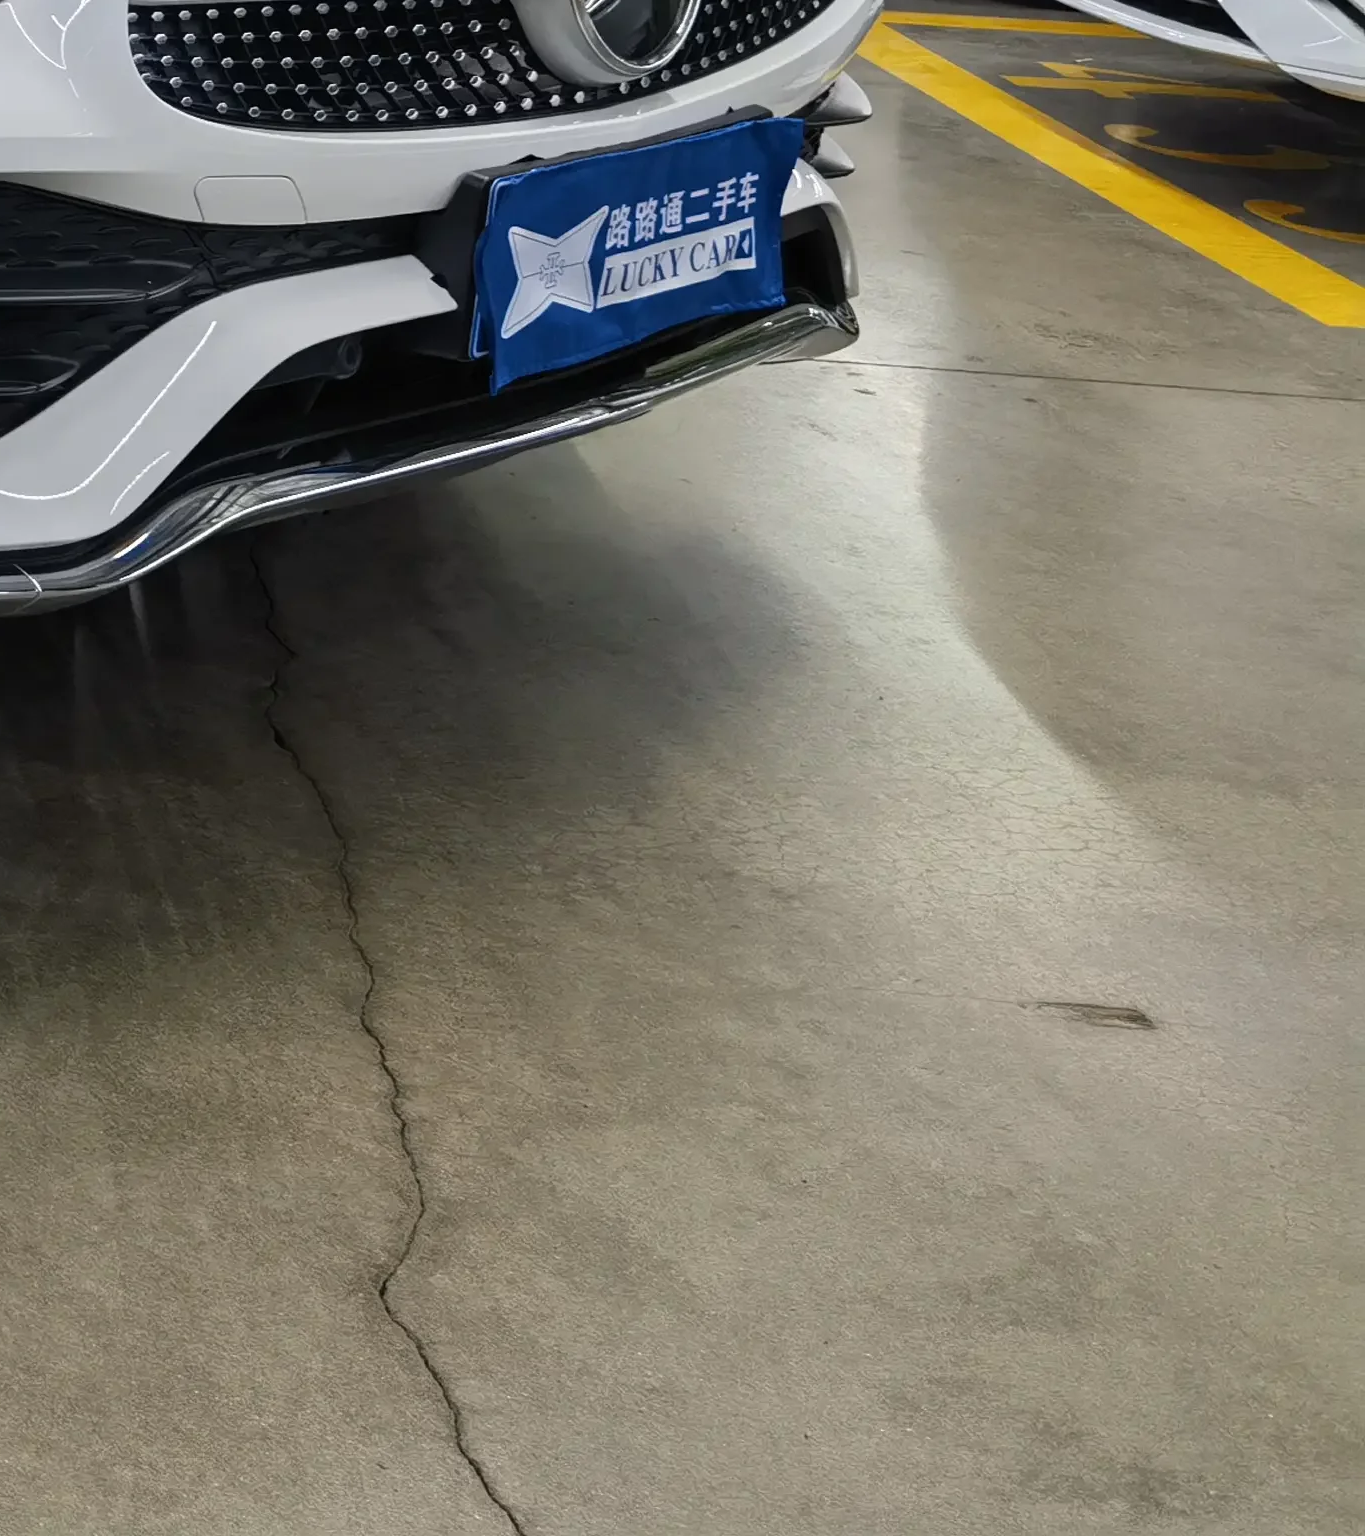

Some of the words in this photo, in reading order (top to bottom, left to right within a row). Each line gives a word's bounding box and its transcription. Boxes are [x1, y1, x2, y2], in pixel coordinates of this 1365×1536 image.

[605, 171, 760, 251] 路路通二手车
[600, 246, 684, 298] LUCKY
[688, 234, 735, 273] CAR
